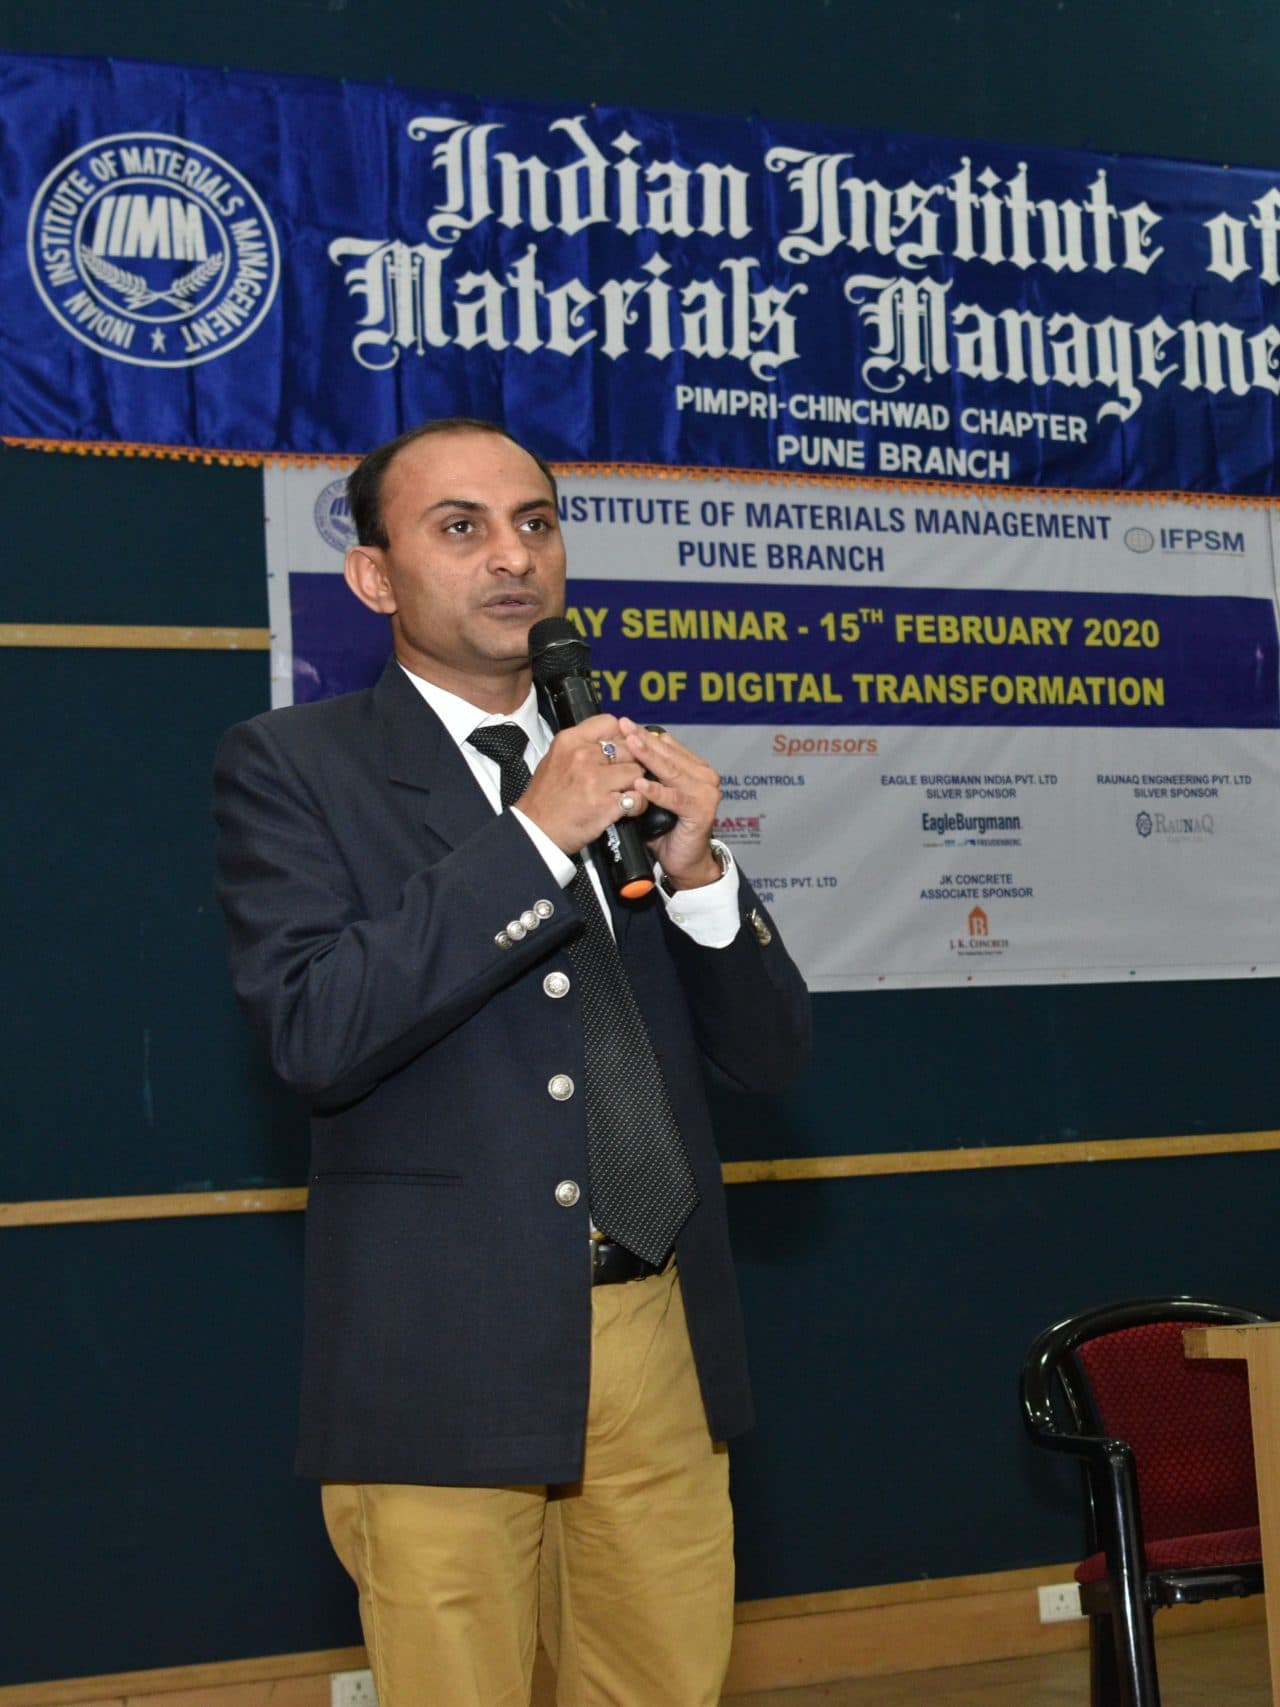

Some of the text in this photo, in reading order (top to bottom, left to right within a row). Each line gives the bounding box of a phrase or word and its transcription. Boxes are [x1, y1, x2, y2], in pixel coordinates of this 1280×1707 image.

[407, 116, 753, 241] Indian
[765, 147, 1164, 274] Institute
[93, 195, 208, 261] IIMM
[41, 147, 268, 351] INDIAN INSTITUTE OF MATERIALS MANAGEMENT
[328, 237, 808, 381] Materials
[675, 384, 1088, 444] PIMPRI-CHINCHWAD CHAPTER
[777, 434, 1011, 480] PUNE BRANCH
[557, 495, 1111, 540] NSTITUTE OF MATERIALS MANAGEMENT
[1160, 528, 1245, 552] IFPSM
[678, 541, 885, 572] PUNE BRANCH
[565, 606, 609, 638] AY
[621, 608, 788, 641] SEMINAR
[895, 614, 1073, 647] FEBRUARY
[1083, 617, 1160, 648] 2020
[639, 671, 688, 702] OF
[700, 671, 843, 703] DIGITAL
[852, 673, 1164, 706] TRANSFORMATION
[773, 734, 879, 755] Sponsors
[743, 775, 805, 786] CONTROLS
[881, 775, 917, 786] EAGLE
[920, 775, 981, 786] BURGMANN
[984, 775, 1012, 785] INDIA
[1039, 775, 1058, 785] LTD
[1097, 775, 1140, 785] RAUNAQ
[1142, 775, 1210, 785] ENGINEERING
[1233, 775, 1252, 785] LTD
[926, 788, 1017, 799] SILVER SPONSOR
[1133, 788, 1218, 798] SILVER SPONSOR
[921, 812, 1021, 835] EagleBurgmann
[817, 876, 838, 888] LTD
[940, 873, 1014, 885] JK CONCRETE
[920, 887, 1035, 899] ASSOCIATE SPONSOR
